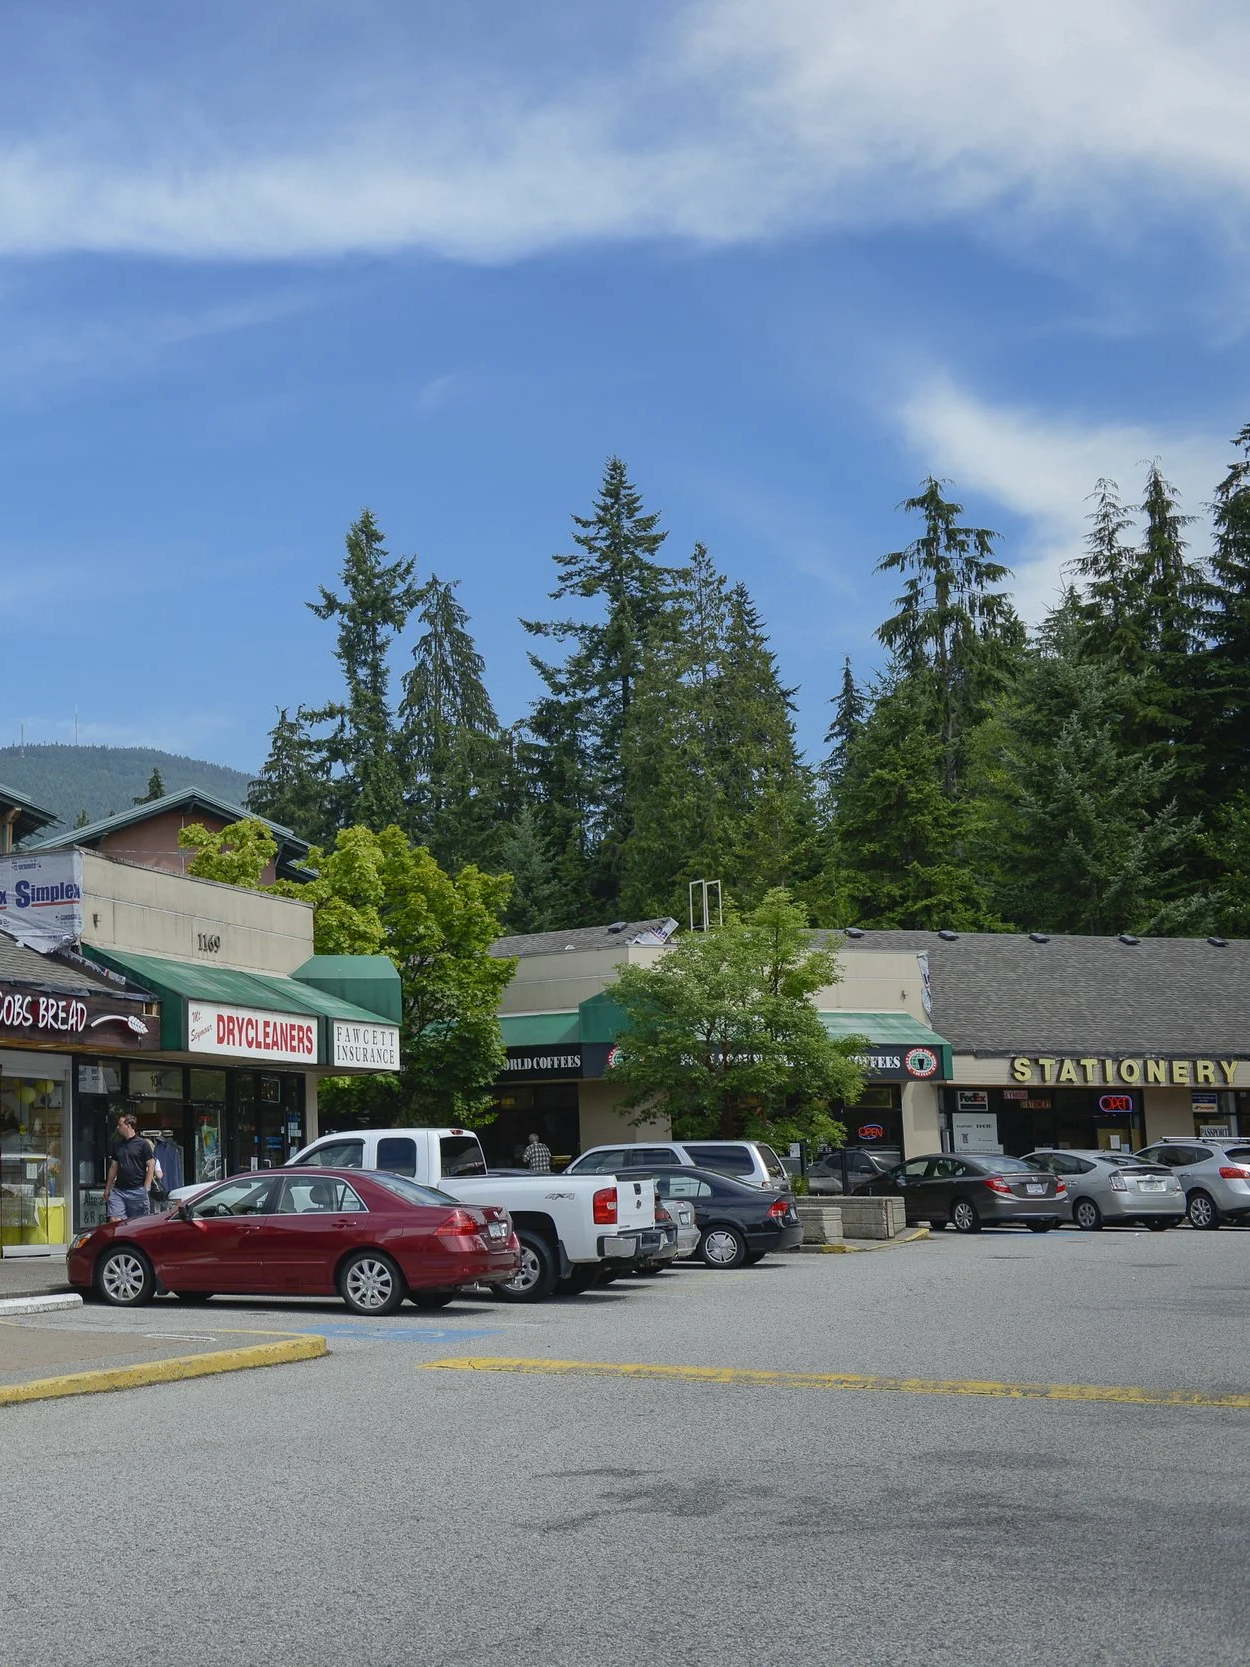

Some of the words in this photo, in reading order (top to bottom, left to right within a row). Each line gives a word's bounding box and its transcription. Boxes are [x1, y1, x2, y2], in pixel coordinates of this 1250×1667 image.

[15, 880, 80, 908] Simplex
[197, 933, 221, 954] 1169
[37, 995, 87, 1033] BREAD
[216, 1013, 313, 1055] DRYCLEANERS
[336, 1026, 395, 1047] FAWCETT
[337, 1045, 395, 1065] INSURANCE
[502, 1057, 532, 1071] ORLD
[533, 1055, 581, 1069] COFFEES
[1013, 1057, 1238, 1083] STATIONERY
[959, 1093, 986, 1102] FedEx
[1102, 1096, 1131, 1111] OPEN
[858, 1127, 883, 1138] OPEN
